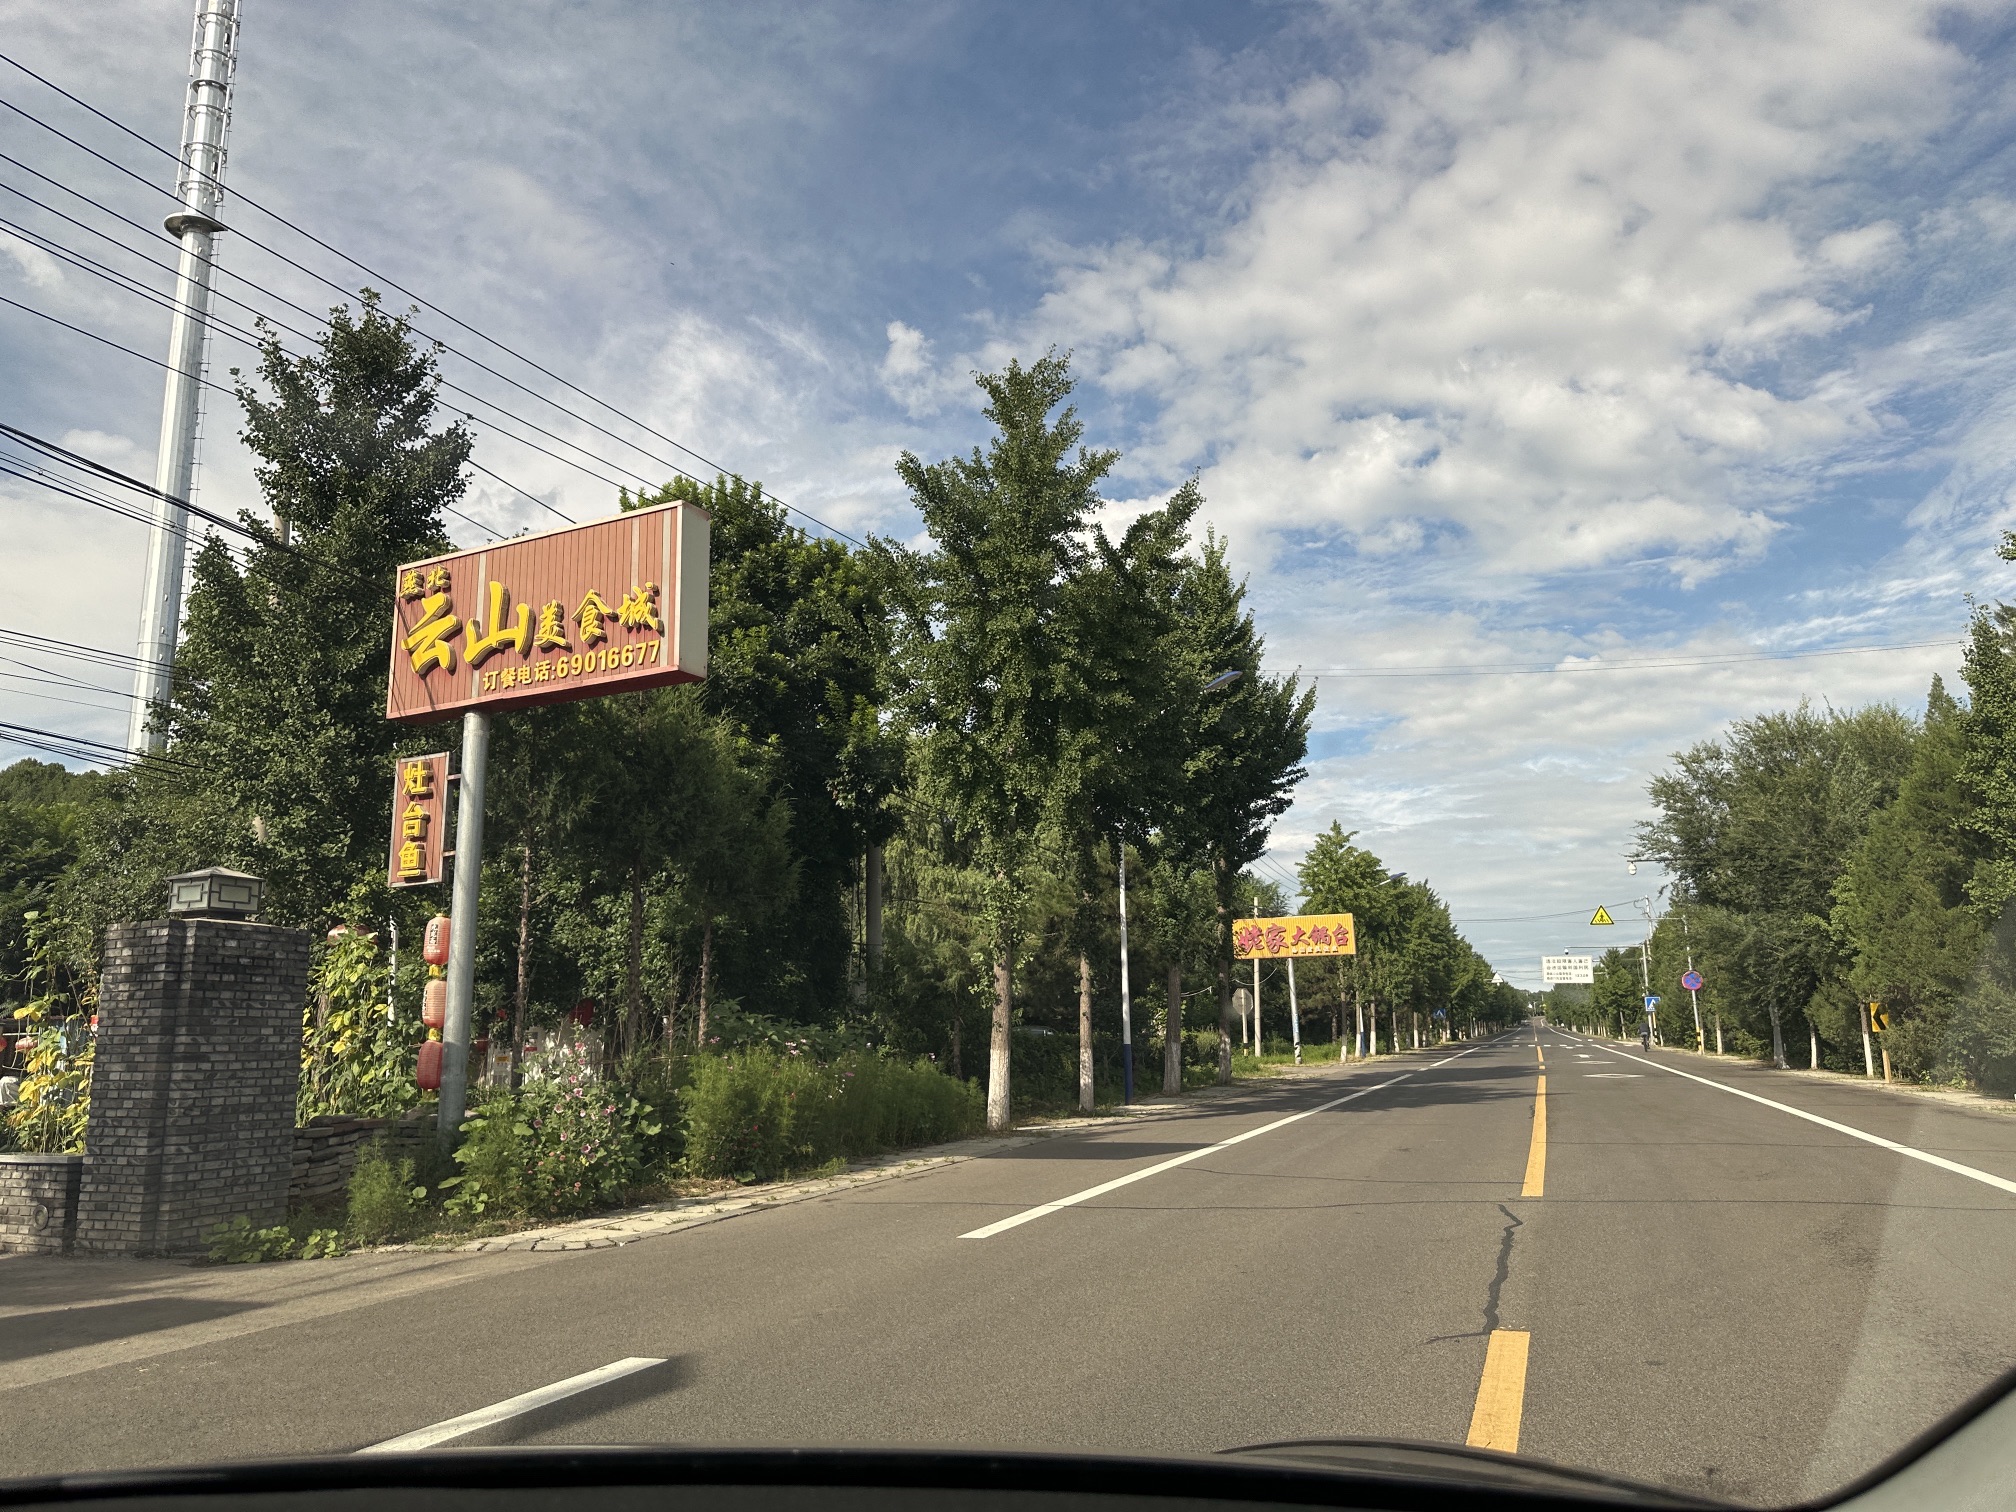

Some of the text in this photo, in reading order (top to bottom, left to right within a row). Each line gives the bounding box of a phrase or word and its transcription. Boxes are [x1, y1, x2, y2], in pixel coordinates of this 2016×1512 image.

[401, 581, 661, 676] 云山美食城
[482, 639, 660, 692] 订餐电话:69016677
[397, 760, 432, 877] 灶台鱼
